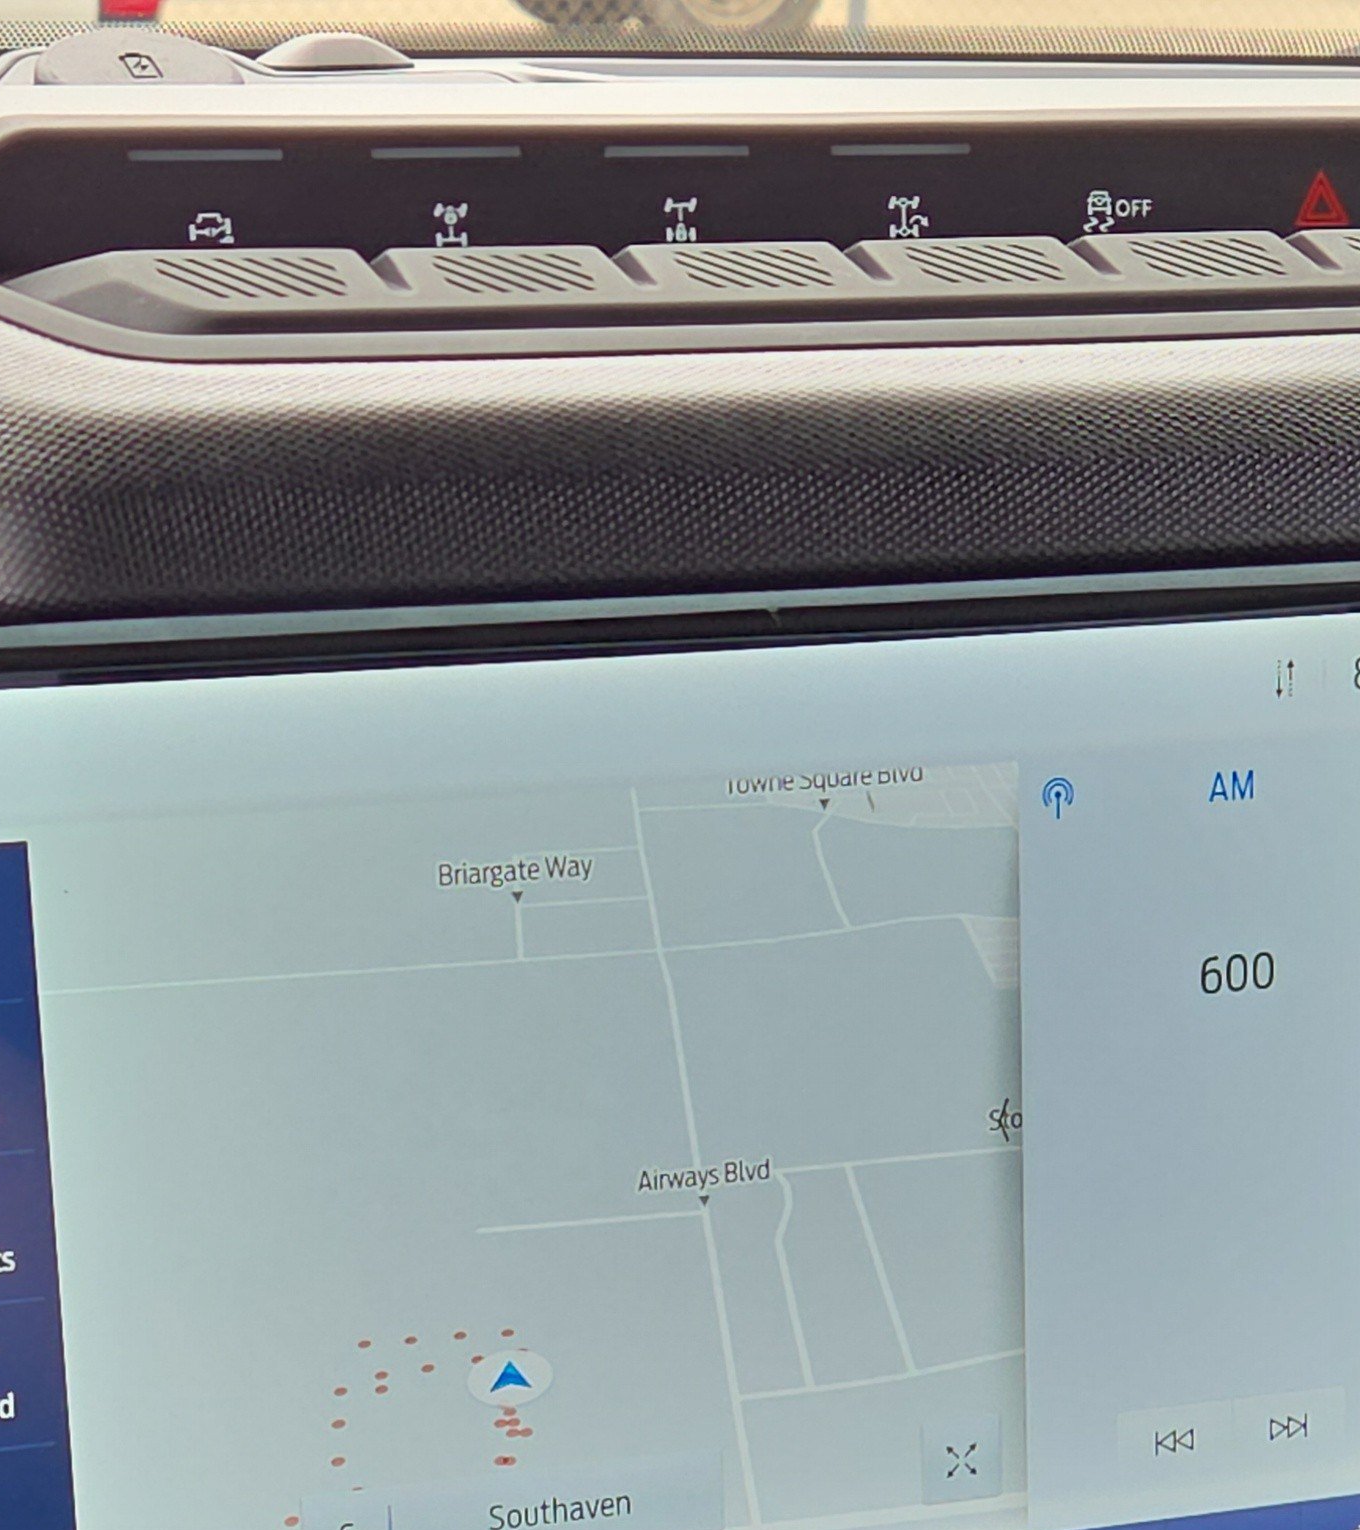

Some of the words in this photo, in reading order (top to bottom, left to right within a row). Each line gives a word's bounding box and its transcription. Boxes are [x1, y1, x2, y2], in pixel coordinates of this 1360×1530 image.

[1115, 198, 1153, 218] OFF
[799, 771, 873, 793] Square
[1208, 769, 1254, 803] AM
[439, 860, 540, 888] Briargate
[544, 856, 592, 881] Way
[1200, 951, 1274, 994] 600
[638, 1168, 719, 1194] Airways
[724, 1158, 770, 1183] Blvd
[489, 1495, 631, 1530] Southaven
